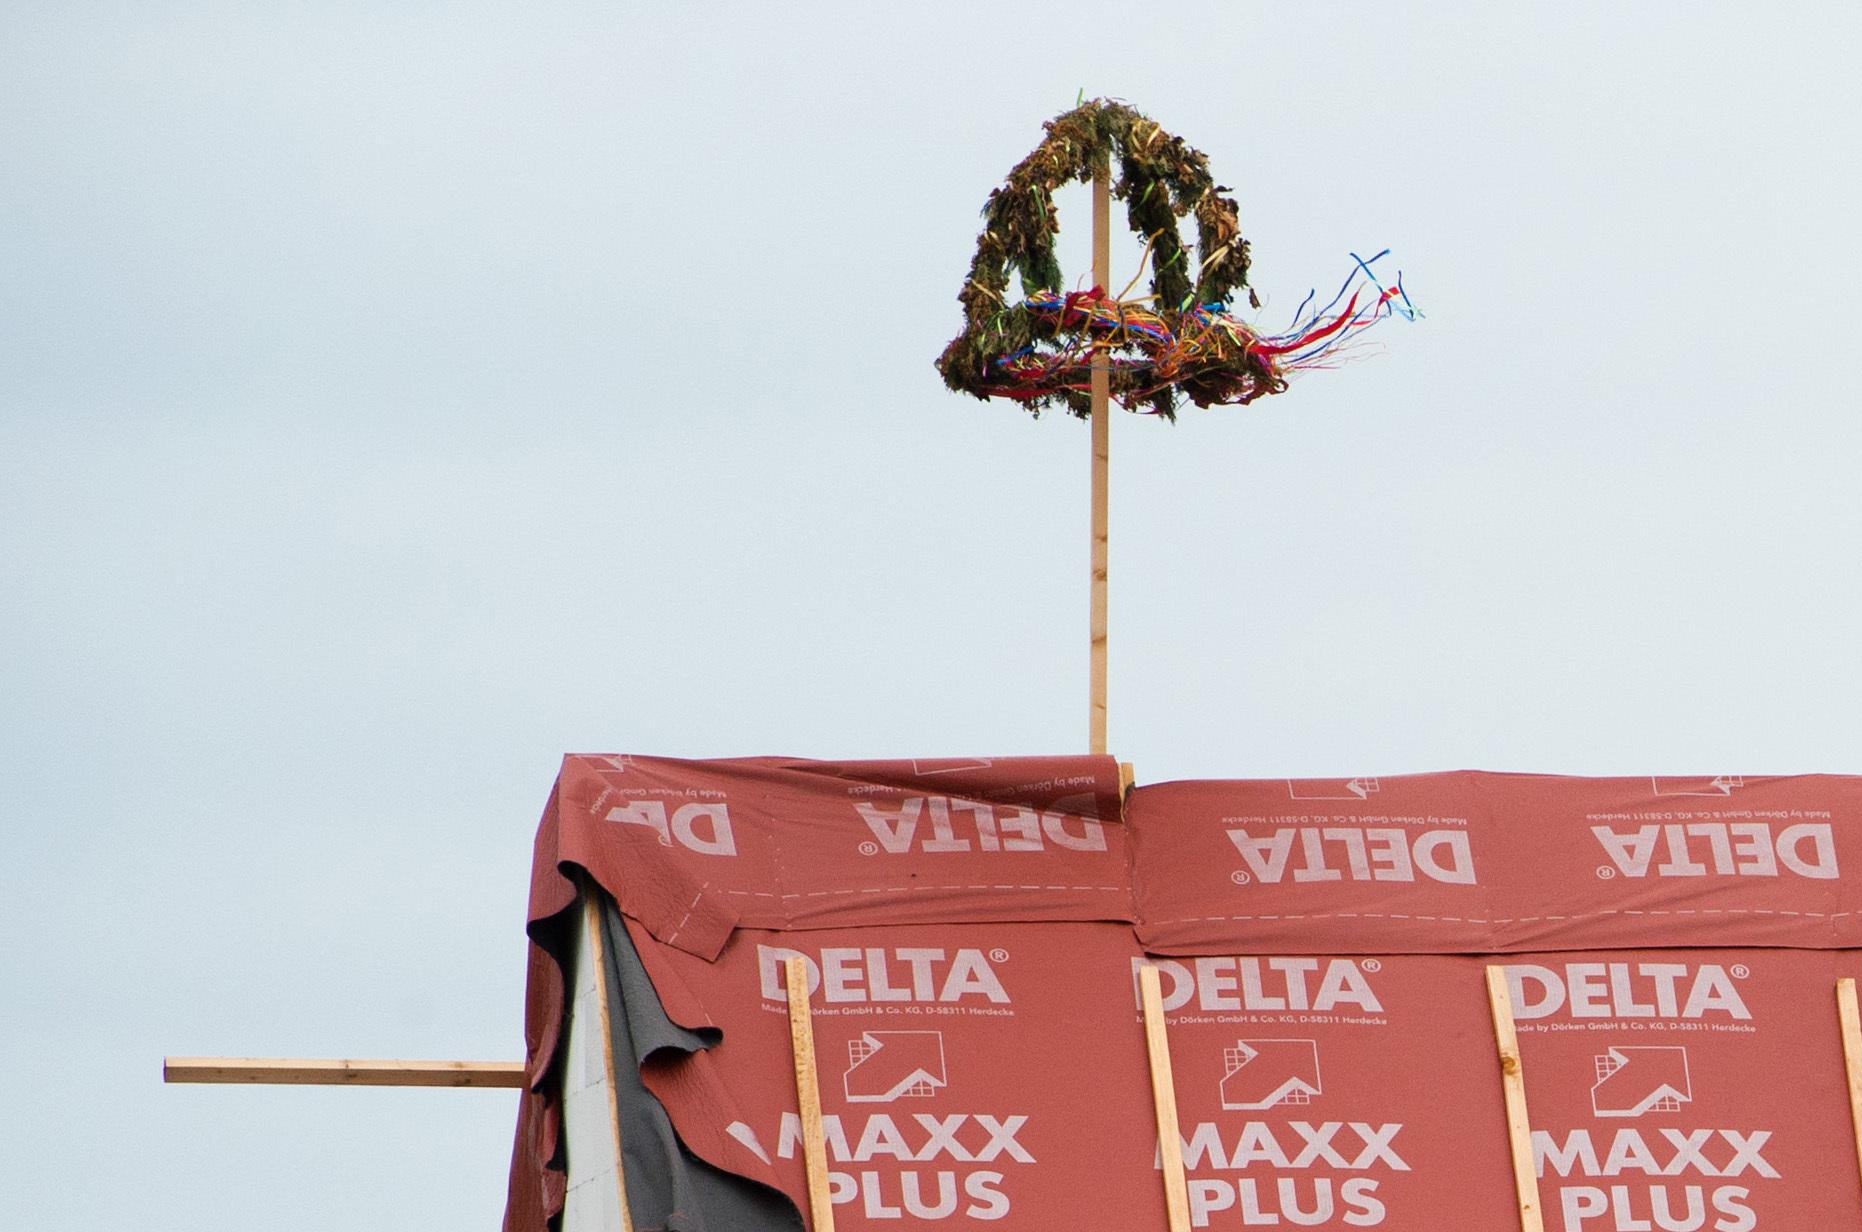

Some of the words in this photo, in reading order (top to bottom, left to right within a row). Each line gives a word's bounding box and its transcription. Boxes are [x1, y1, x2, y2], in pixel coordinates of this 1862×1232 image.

[812, 1007, 840, 1016] örken
[1516, 1023, 1535, 1033] ade
[1537, 1022, 1549, 1033] by
[1530, 1128, 1782, 1179] MAXX
[1187, 1177, 1386, 1227] PLUS
